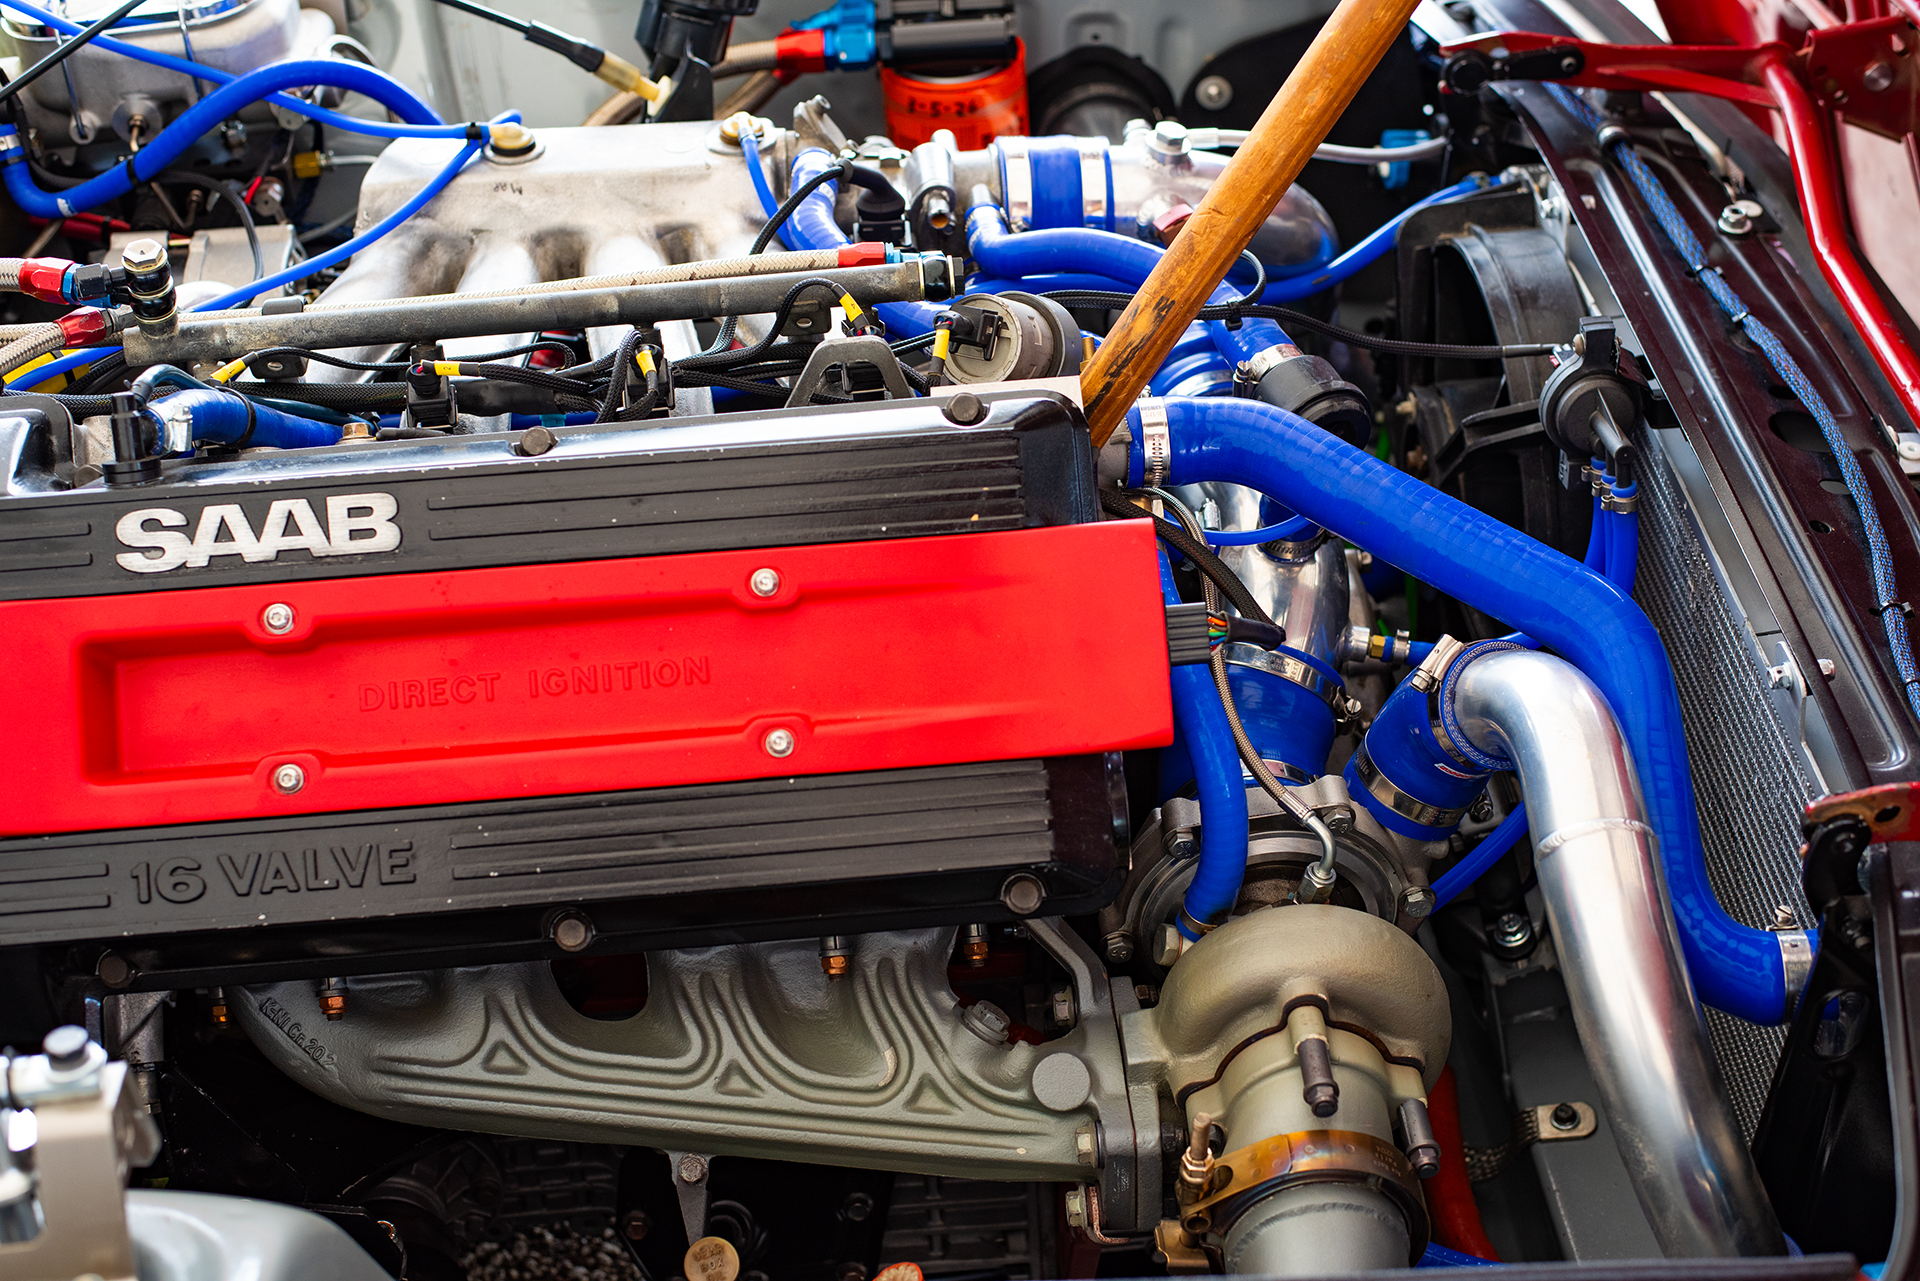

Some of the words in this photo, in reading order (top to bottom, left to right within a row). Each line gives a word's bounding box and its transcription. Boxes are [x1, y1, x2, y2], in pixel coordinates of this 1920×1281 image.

[115, 492, 402, 573] SAAB
[359, 673, 501, 712] DIRECT
[529, 656, 711, 698] IGNITION
[131, 857, 207, 904] 16
[217, 841, 417, 897] VALVE
[692, 1244, 724, 1262] GEAR
[700, 1258, 724, 1273] BOX
